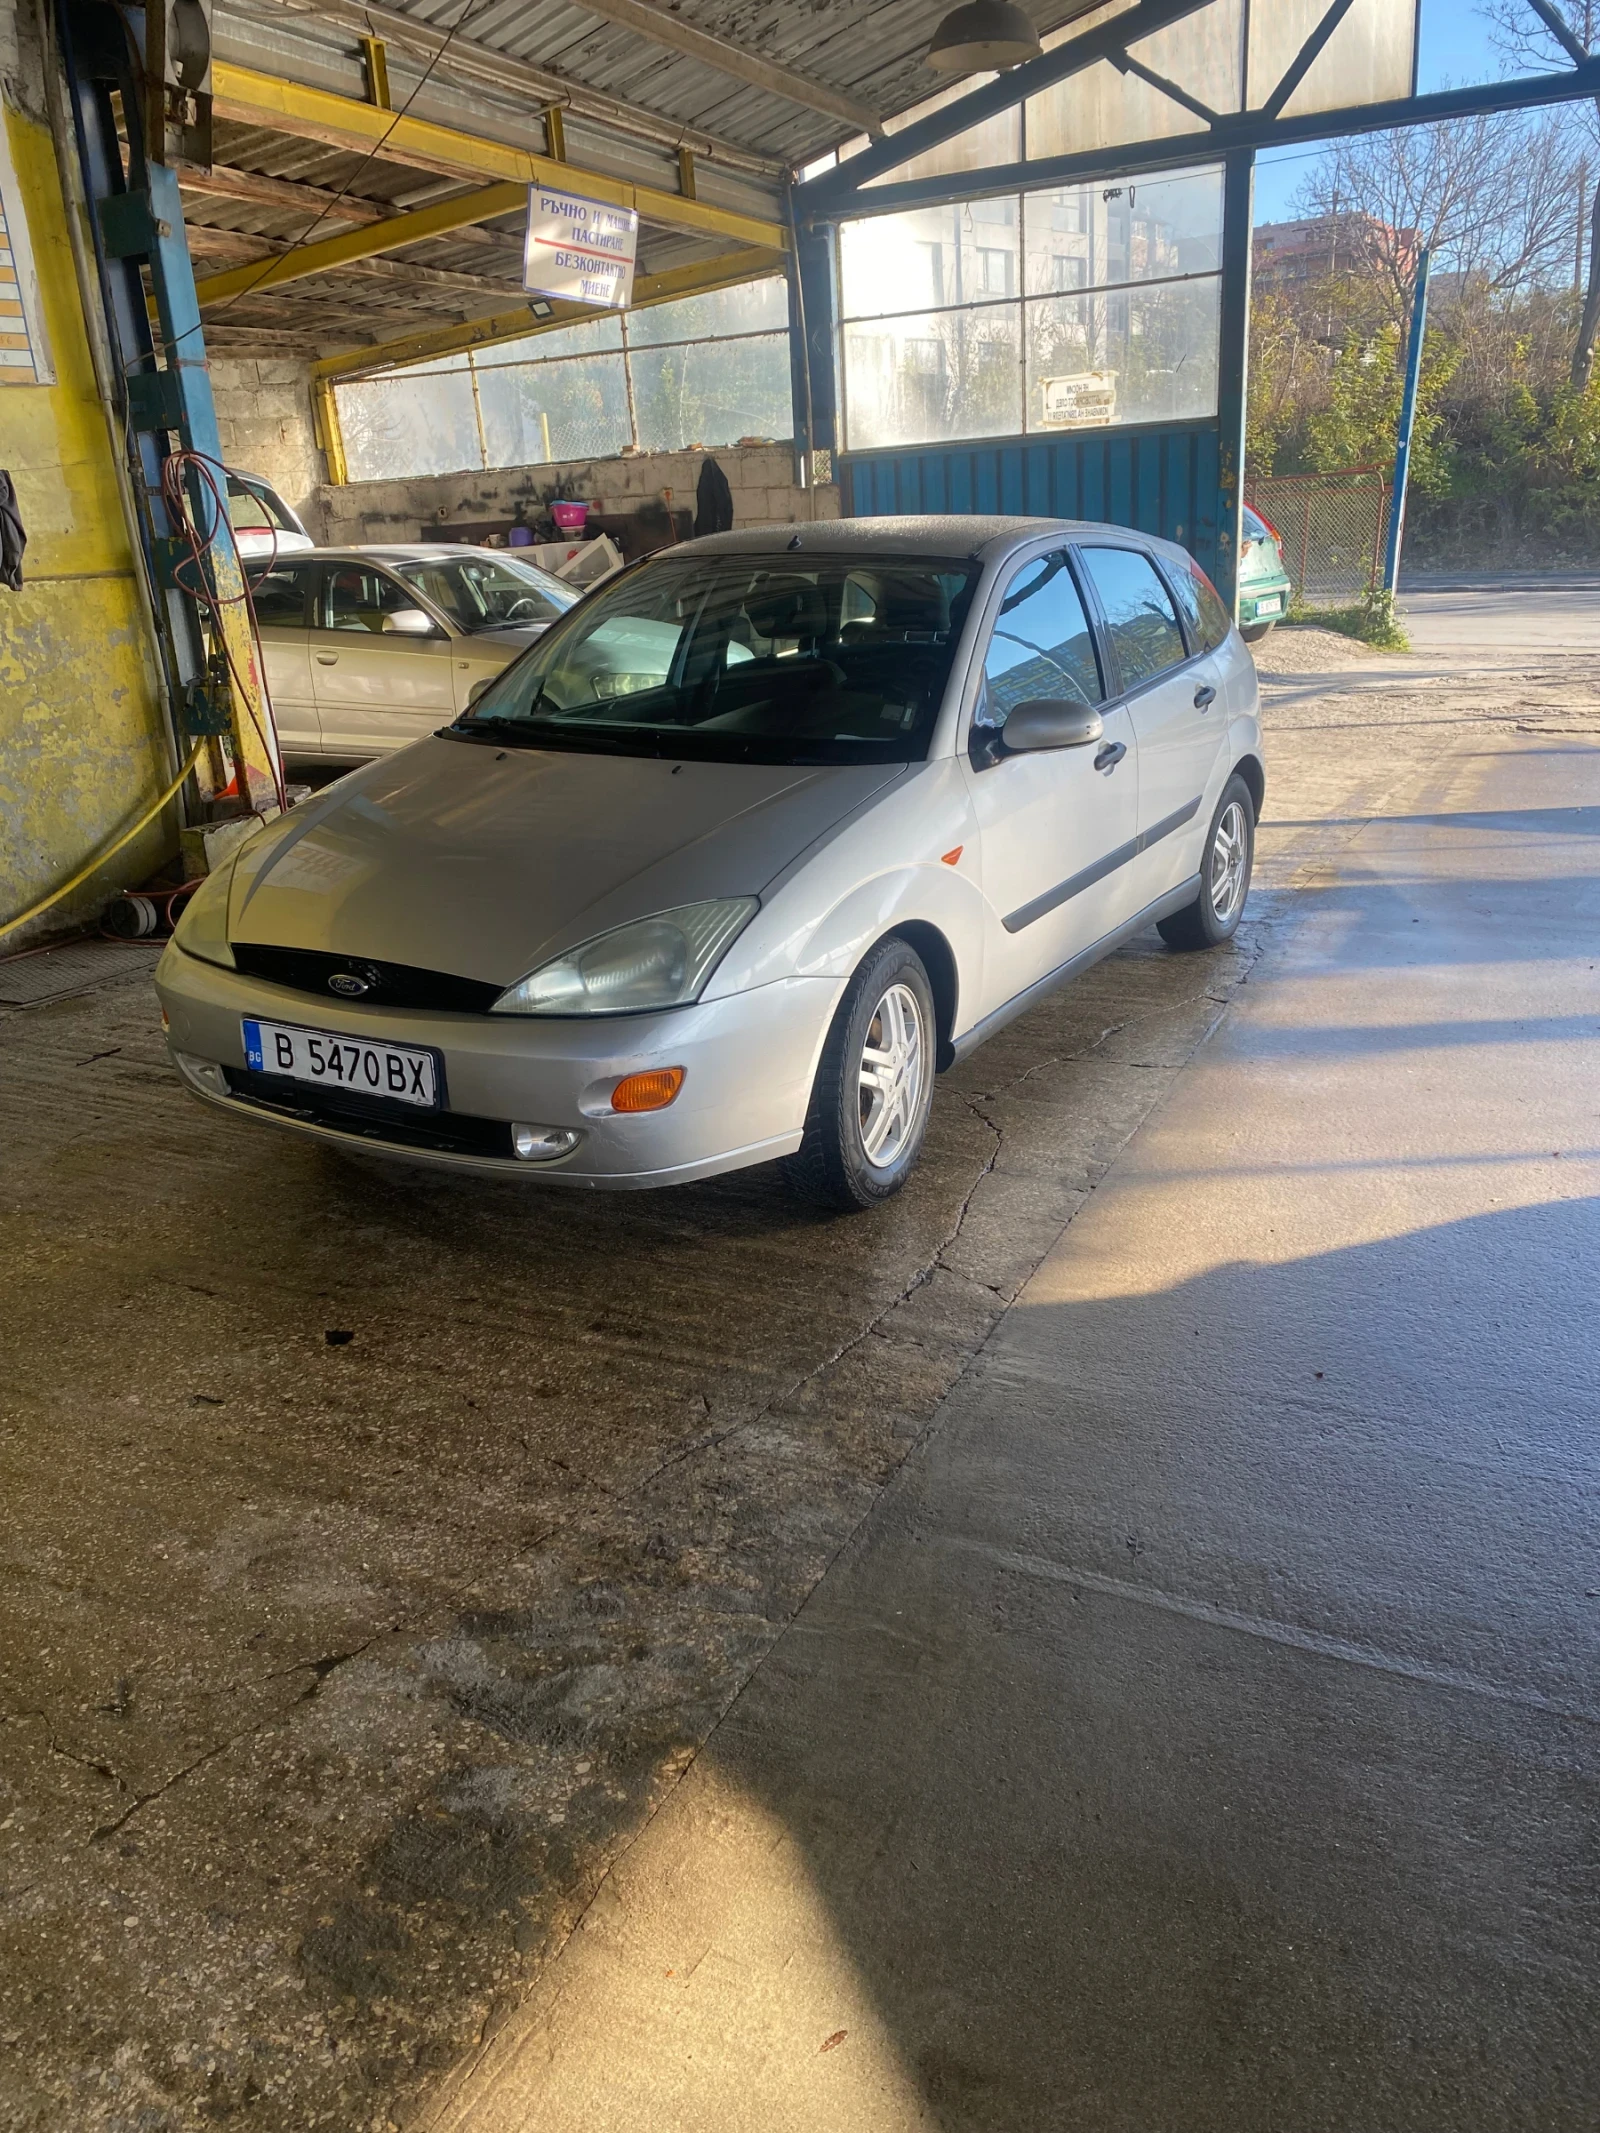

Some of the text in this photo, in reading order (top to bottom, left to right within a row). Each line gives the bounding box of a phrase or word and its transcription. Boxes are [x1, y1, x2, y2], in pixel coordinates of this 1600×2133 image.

[541, 198, 587, 220] РЪЧНО
[592, 210, 601, 225] И
[572, 227, 624, 251] ПАСТИРАНЕ
[555, 252, 626, 279] БЕЗКОНТАКТНО
[580, 280, 611, 298] МИЕНЕ
[335, 978, 356, 991] Ford
[249, 1050, 262, 1063] BG
[274, 1032, 294, 1069] B
